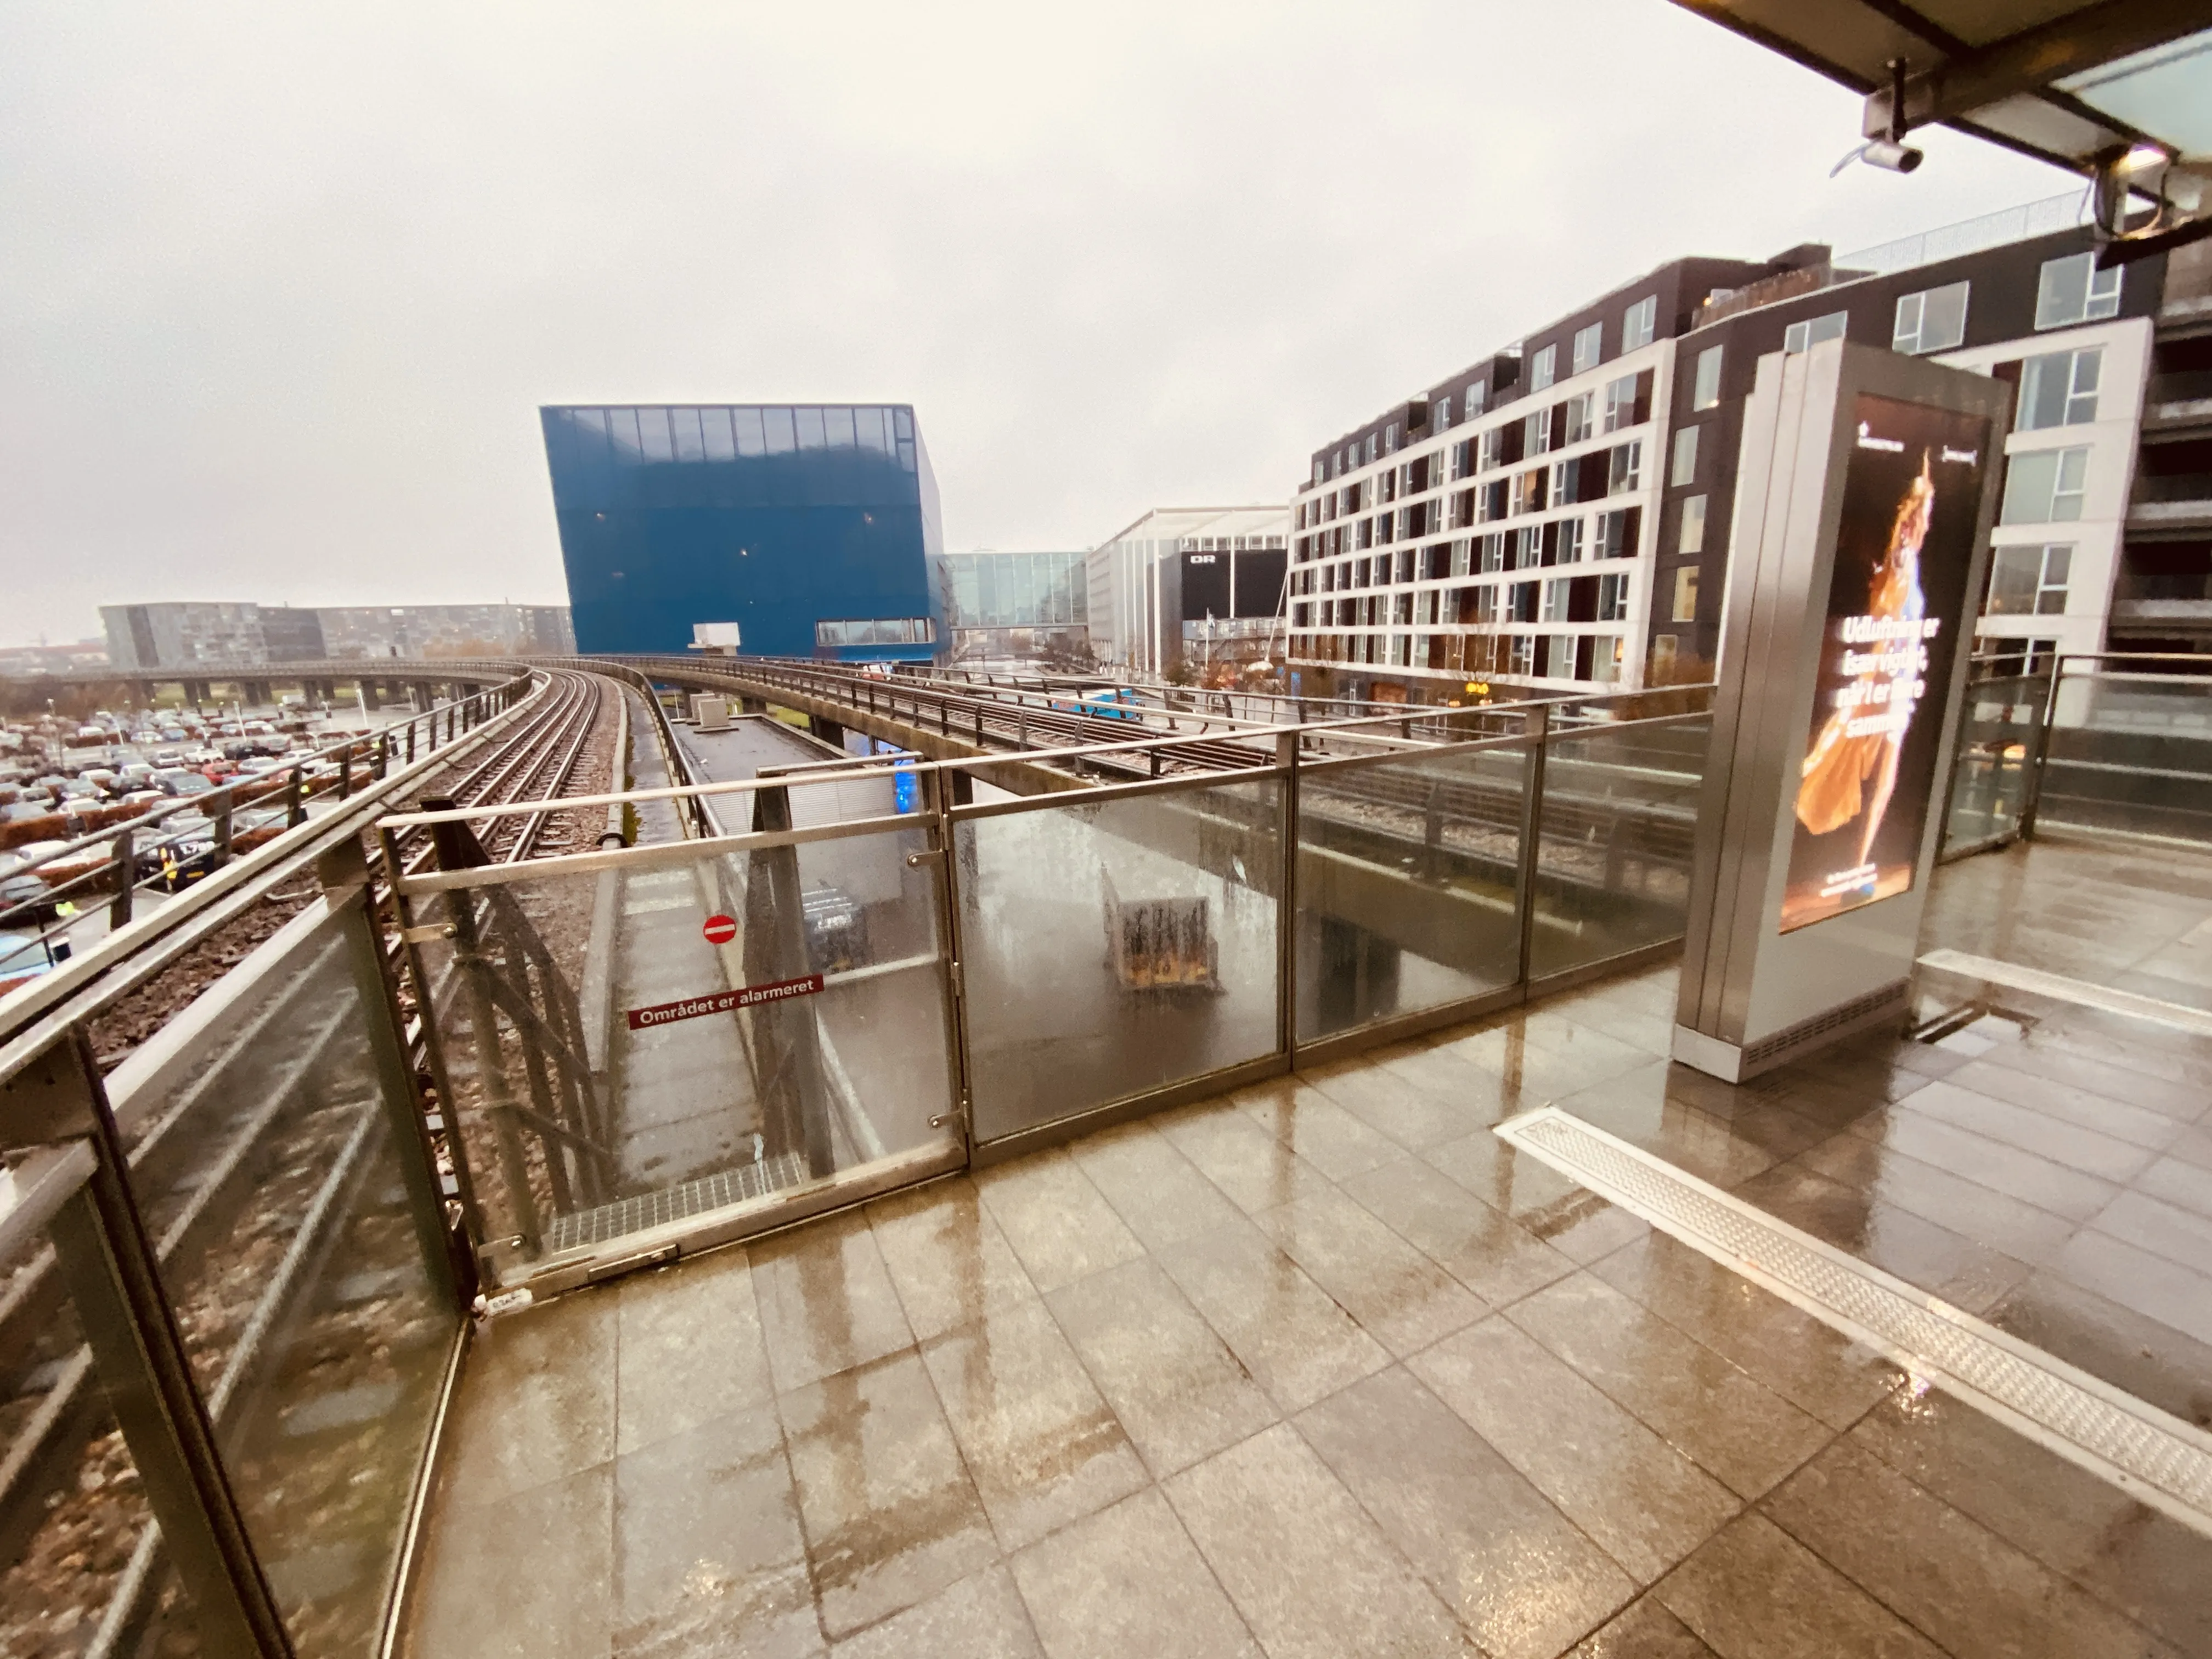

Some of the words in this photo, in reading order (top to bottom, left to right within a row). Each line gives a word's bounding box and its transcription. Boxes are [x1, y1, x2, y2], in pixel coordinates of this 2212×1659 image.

[1190, 555, 1216, 564] DR
[1923, 618, 1940, 637] er
[1847, 713, 1908, 738] samm
[640, 999, 714, 1024] Området
[718, 997, 735, 1008] er
[740, 979, 815, 1005] alarmeret
